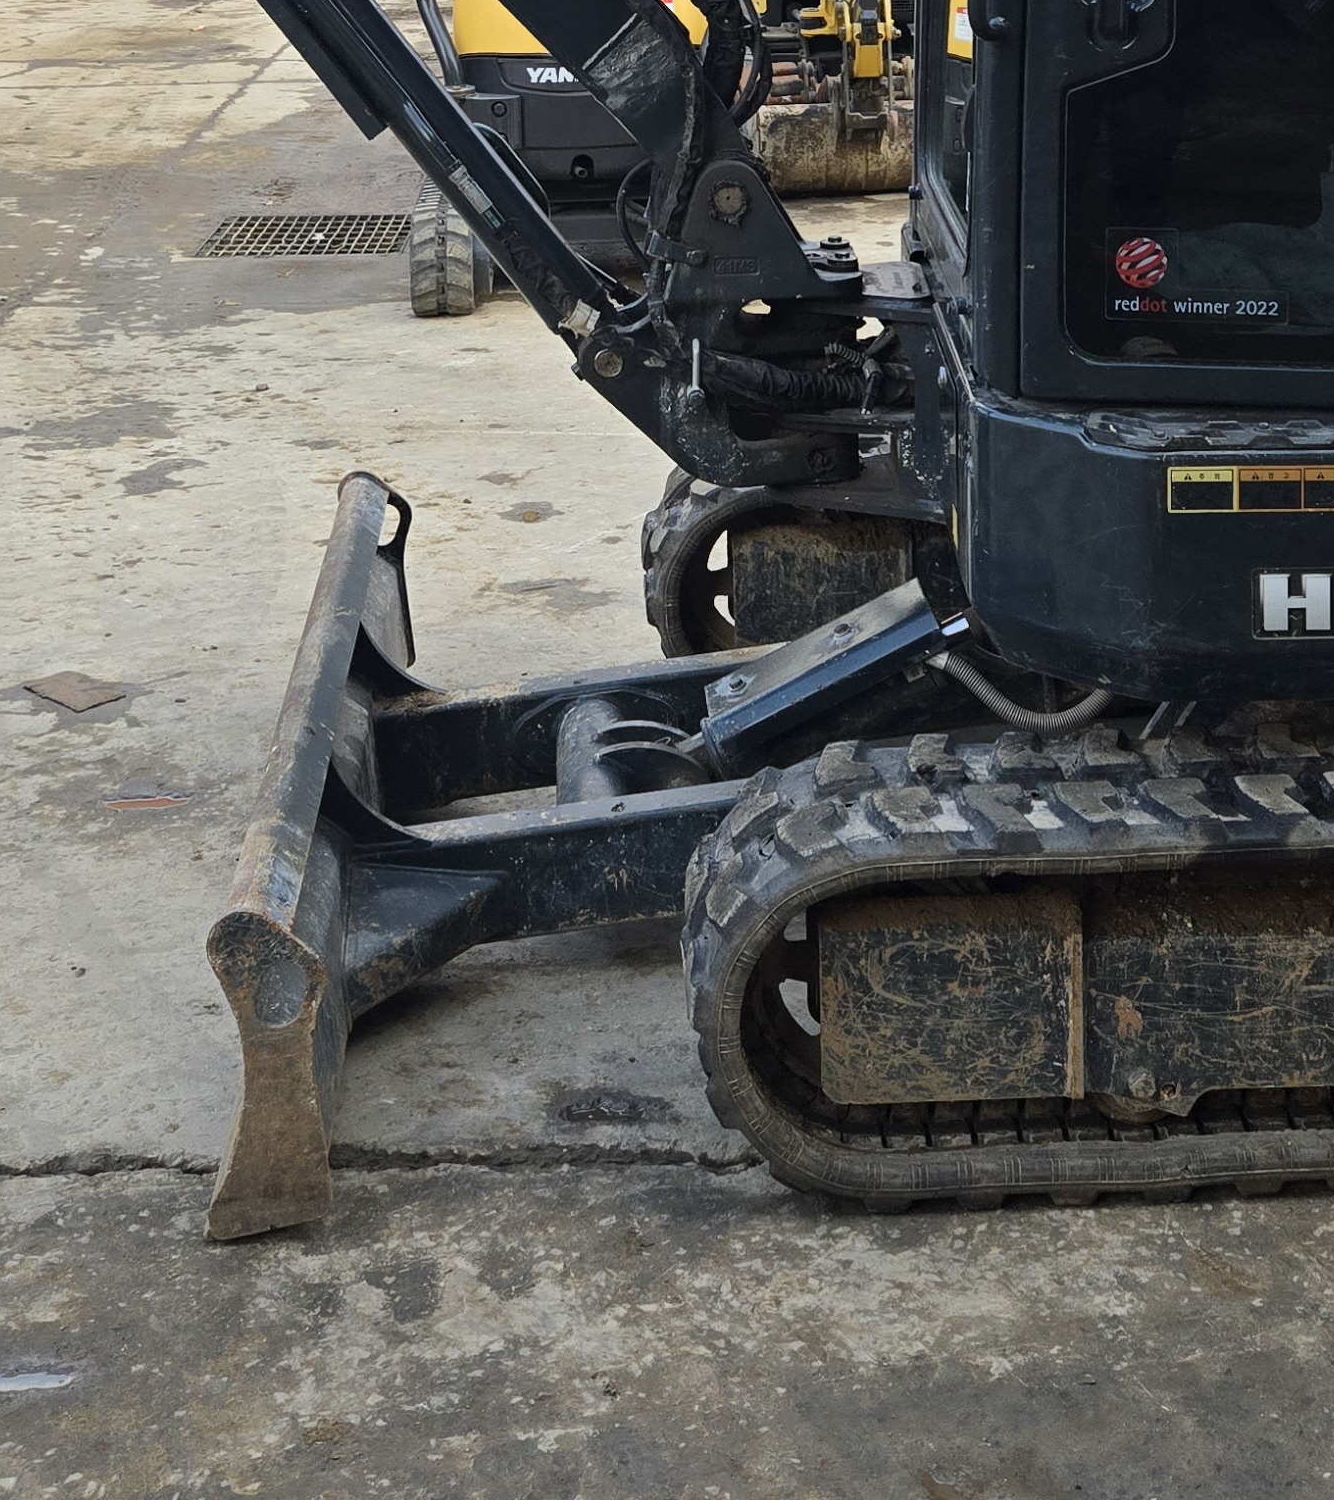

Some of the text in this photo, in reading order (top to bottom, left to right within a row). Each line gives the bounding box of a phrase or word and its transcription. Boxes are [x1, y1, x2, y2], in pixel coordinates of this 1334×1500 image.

[526, 67, 580, 83] YAN
[1173, 297, 1231, 315] winner
[1235, 300, 1280, 316] 2022
